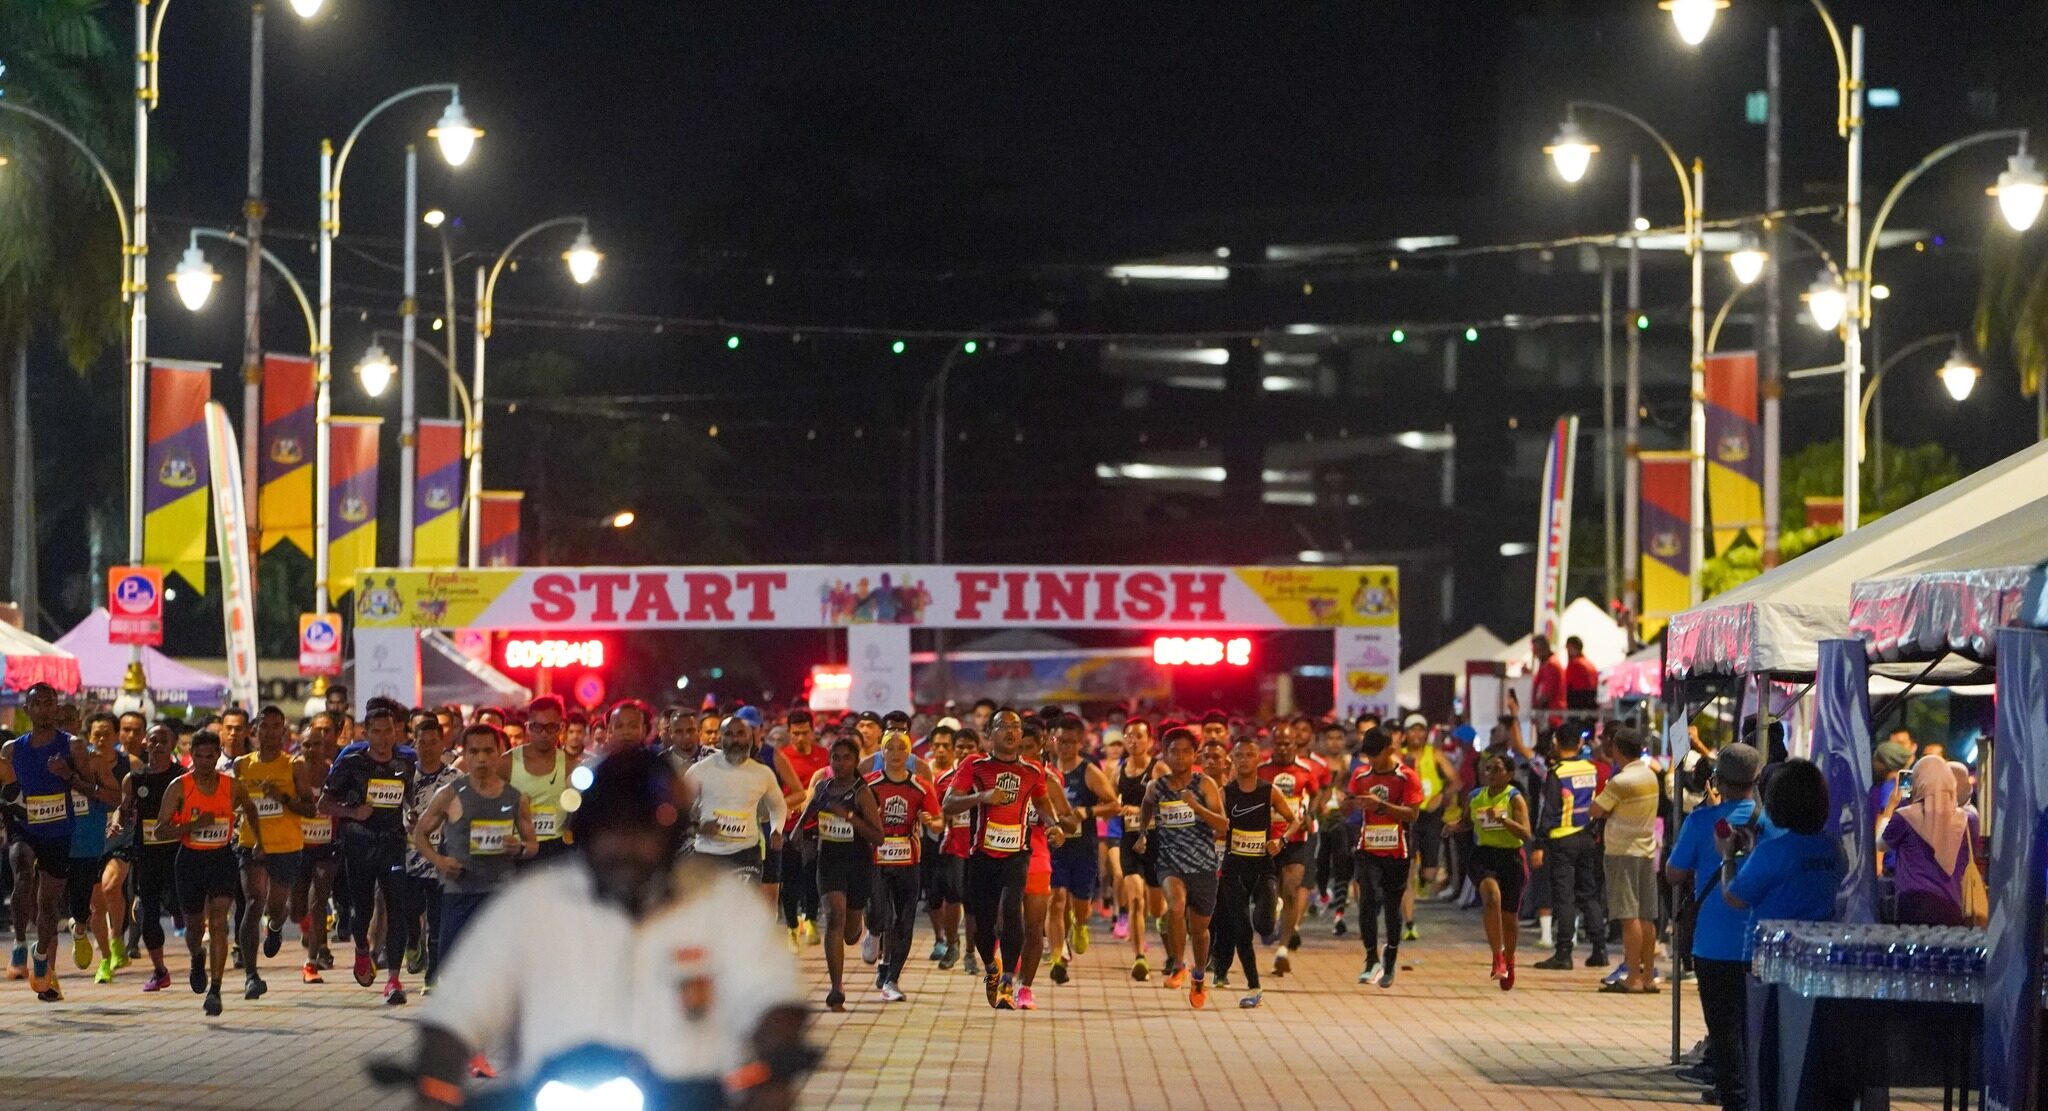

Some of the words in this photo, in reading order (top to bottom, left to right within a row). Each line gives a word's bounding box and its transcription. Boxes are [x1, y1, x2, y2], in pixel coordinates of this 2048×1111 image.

[530, 573, 787, 622] START
[955, 572, 1226, 620] FINISH
[156, 688, 188, 702] IPOH
[378, 791, 403, 800] D4047
[885, 816, 905, 825] IPOH
[996, 835, 1019, 845] F6091
